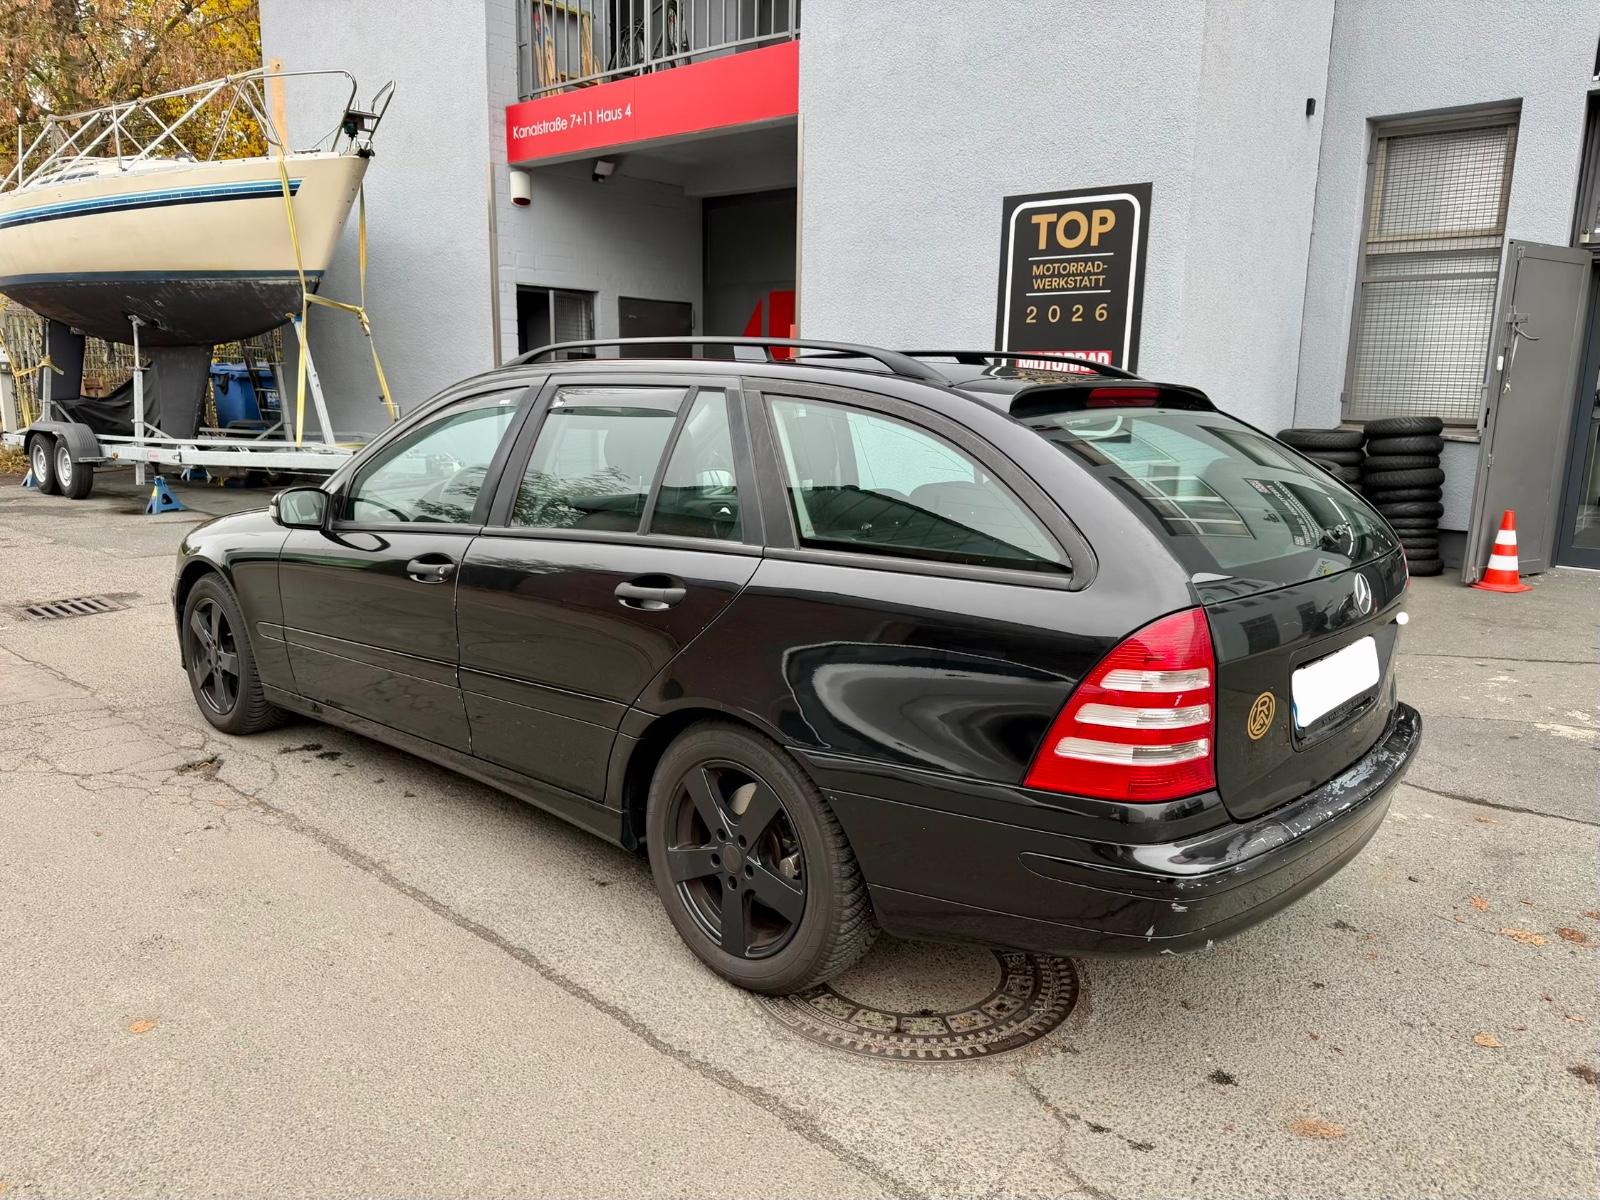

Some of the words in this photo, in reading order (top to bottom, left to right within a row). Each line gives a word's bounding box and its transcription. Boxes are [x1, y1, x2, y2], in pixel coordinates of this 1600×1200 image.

[513, 117, 567, 139] Kanalstraße
[570, 111, 593, 128] 7+11
[597, 107, 622, 123] Haus
[624, 103, 632, 118] 4
[1031, 208, 1116, 250] TOP
[1032, 261, 1108, 276] MOTORRAD-
[1032, 275, 1106, 290] WERKSTATT
